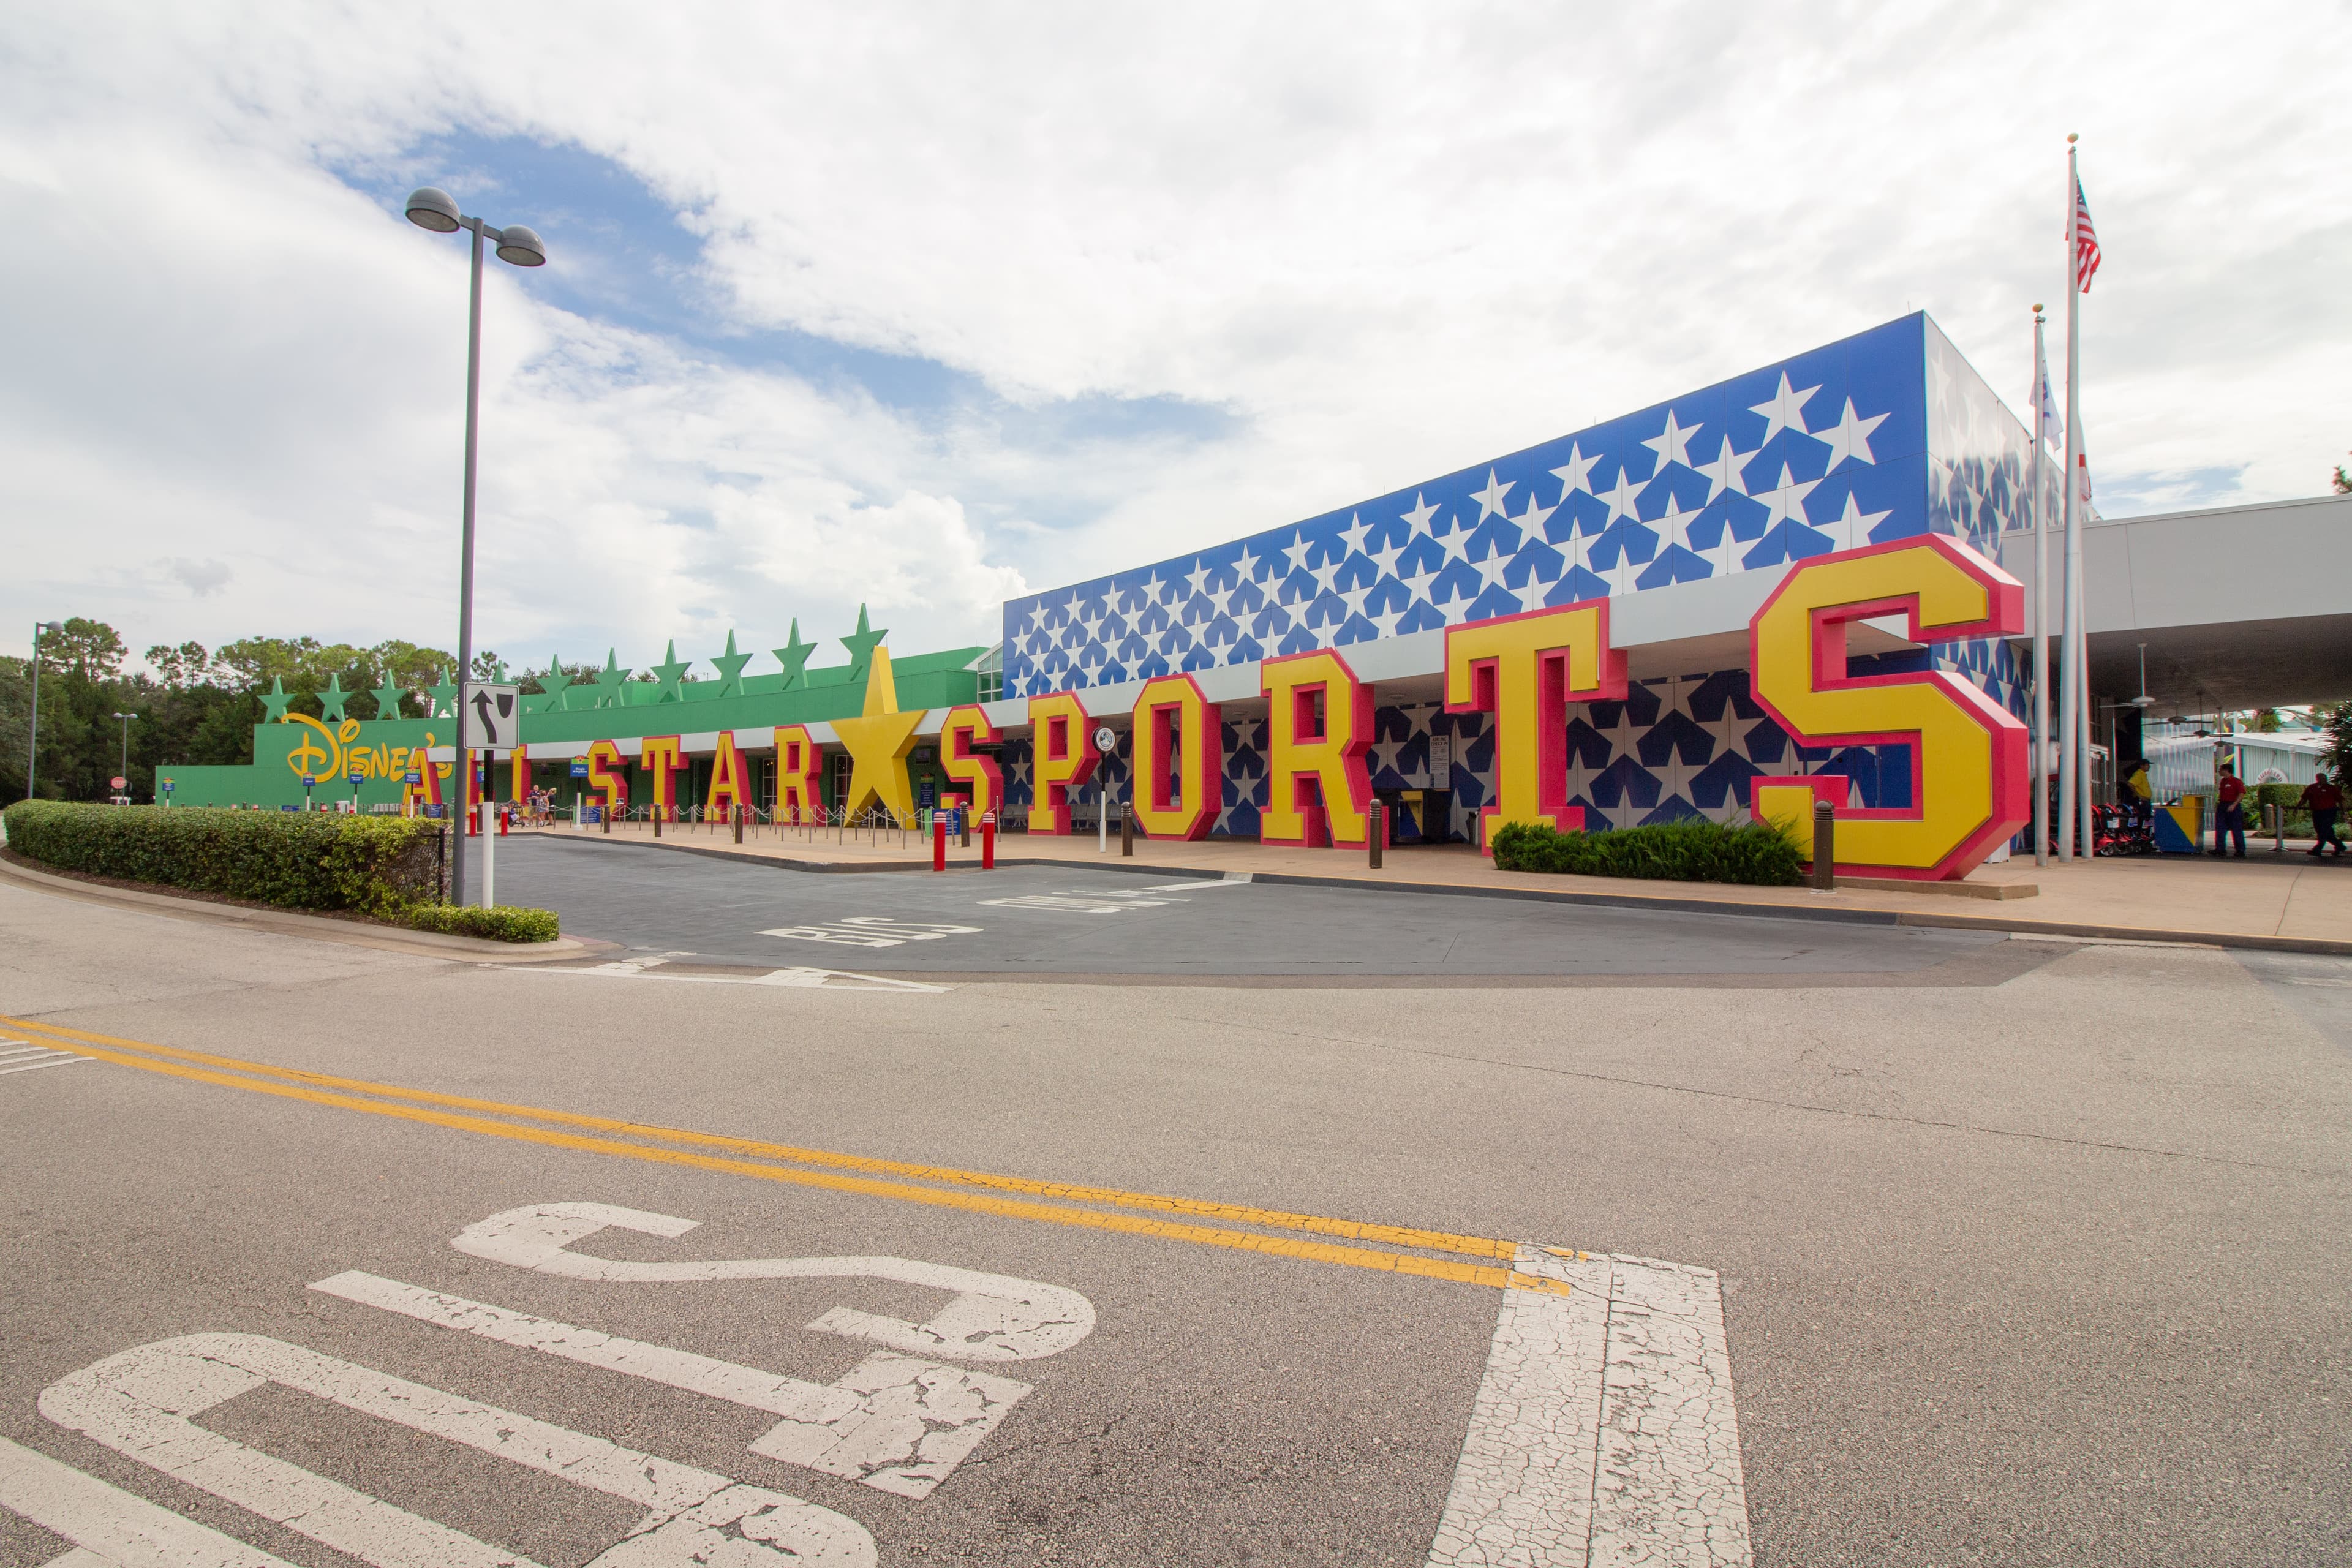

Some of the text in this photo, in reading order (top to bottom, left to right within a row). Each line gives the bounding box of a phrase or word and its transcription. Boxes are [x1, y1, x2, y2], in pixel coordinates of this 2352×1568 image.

[586, 724, 823, 826] STAR
[940, 533, 2029, 881] SPORTS
[752, 916, 985, 948] BUS
